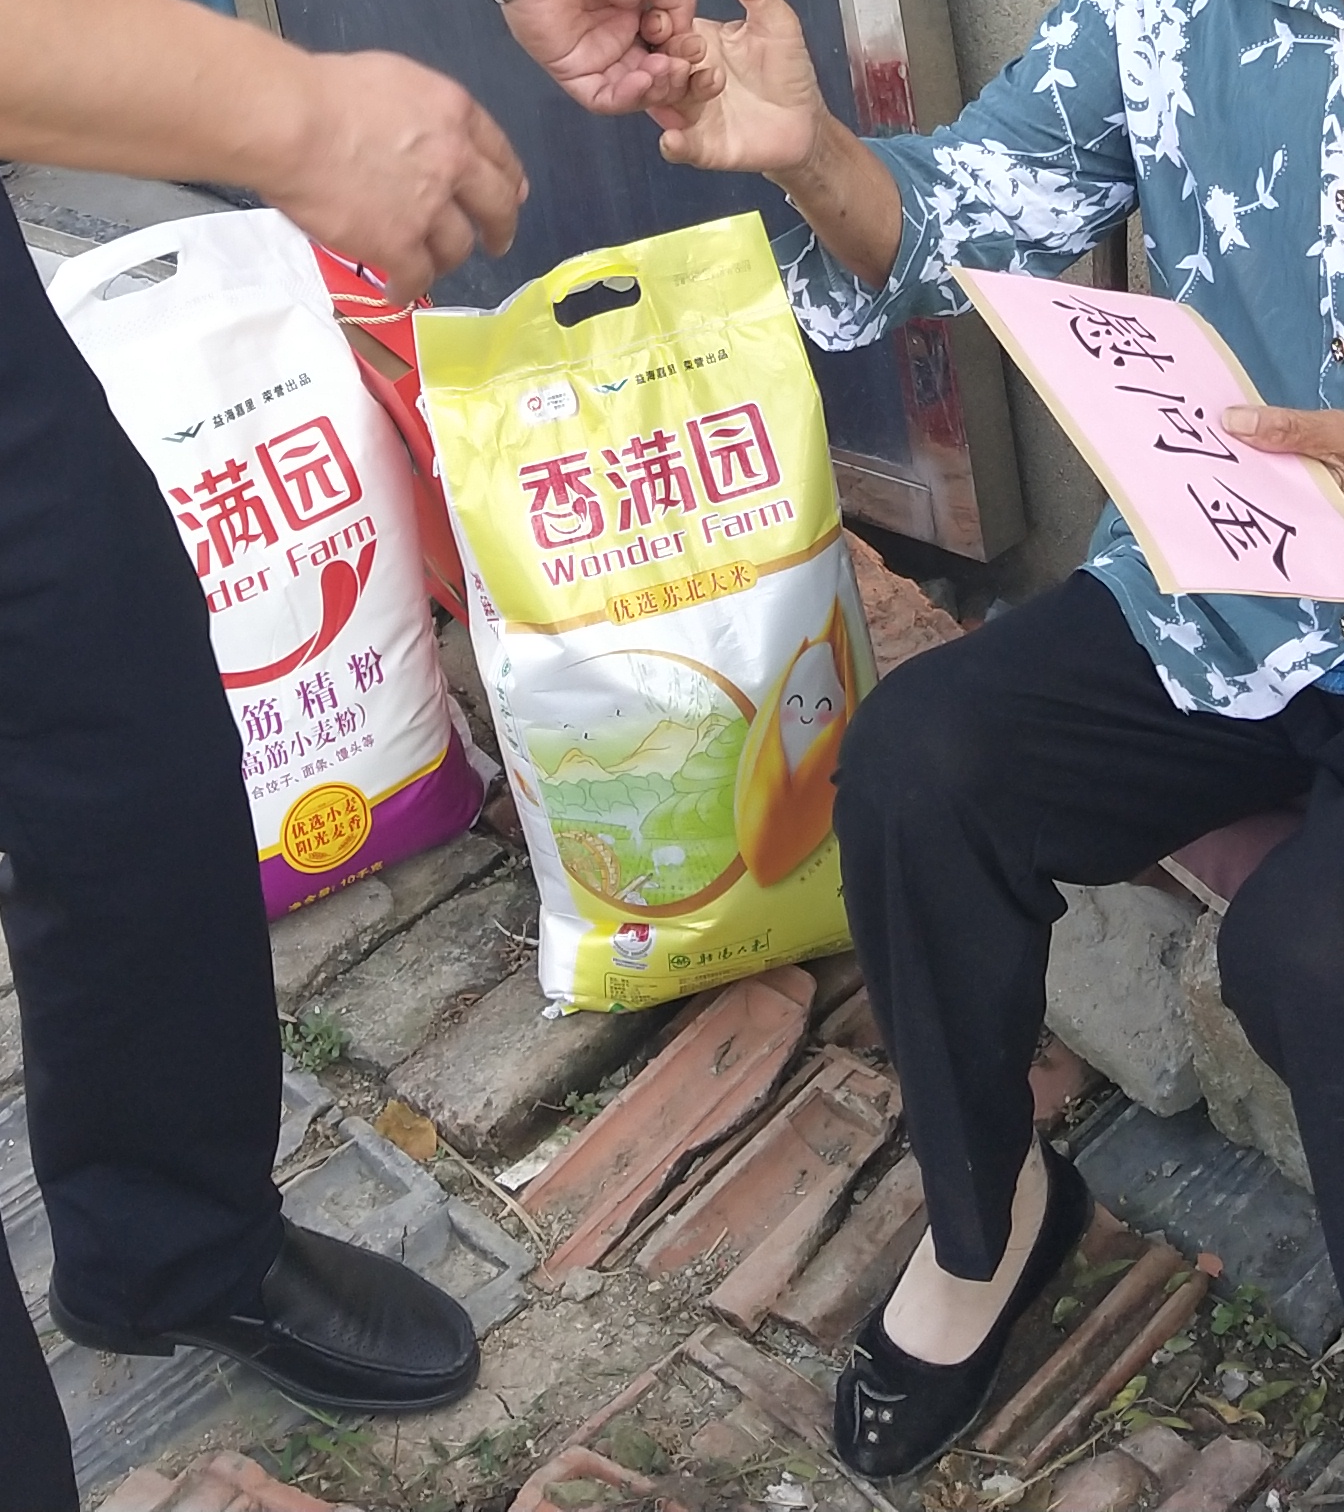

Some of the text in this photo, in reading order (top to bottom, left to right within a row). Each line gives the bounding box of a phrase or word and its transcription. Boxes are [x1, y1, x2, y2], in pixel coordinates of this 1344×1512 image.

[212, 372, 312, 429] 益海嘉里 荣誉出品
[1051, 294, 1297, 582] 慰问金
[167, 415, 363, 579] 满园
[518, 403, 781, 550] 香满园
[285, 515, 377, 578] Farm
[541, 499, 794, 586] Wonder Farm
[613, 565, 751, 622] 优选苏北大米
[291, 796, 358, 840] 优选小麦
[294, 814, 361, 857] 阳光麦香
